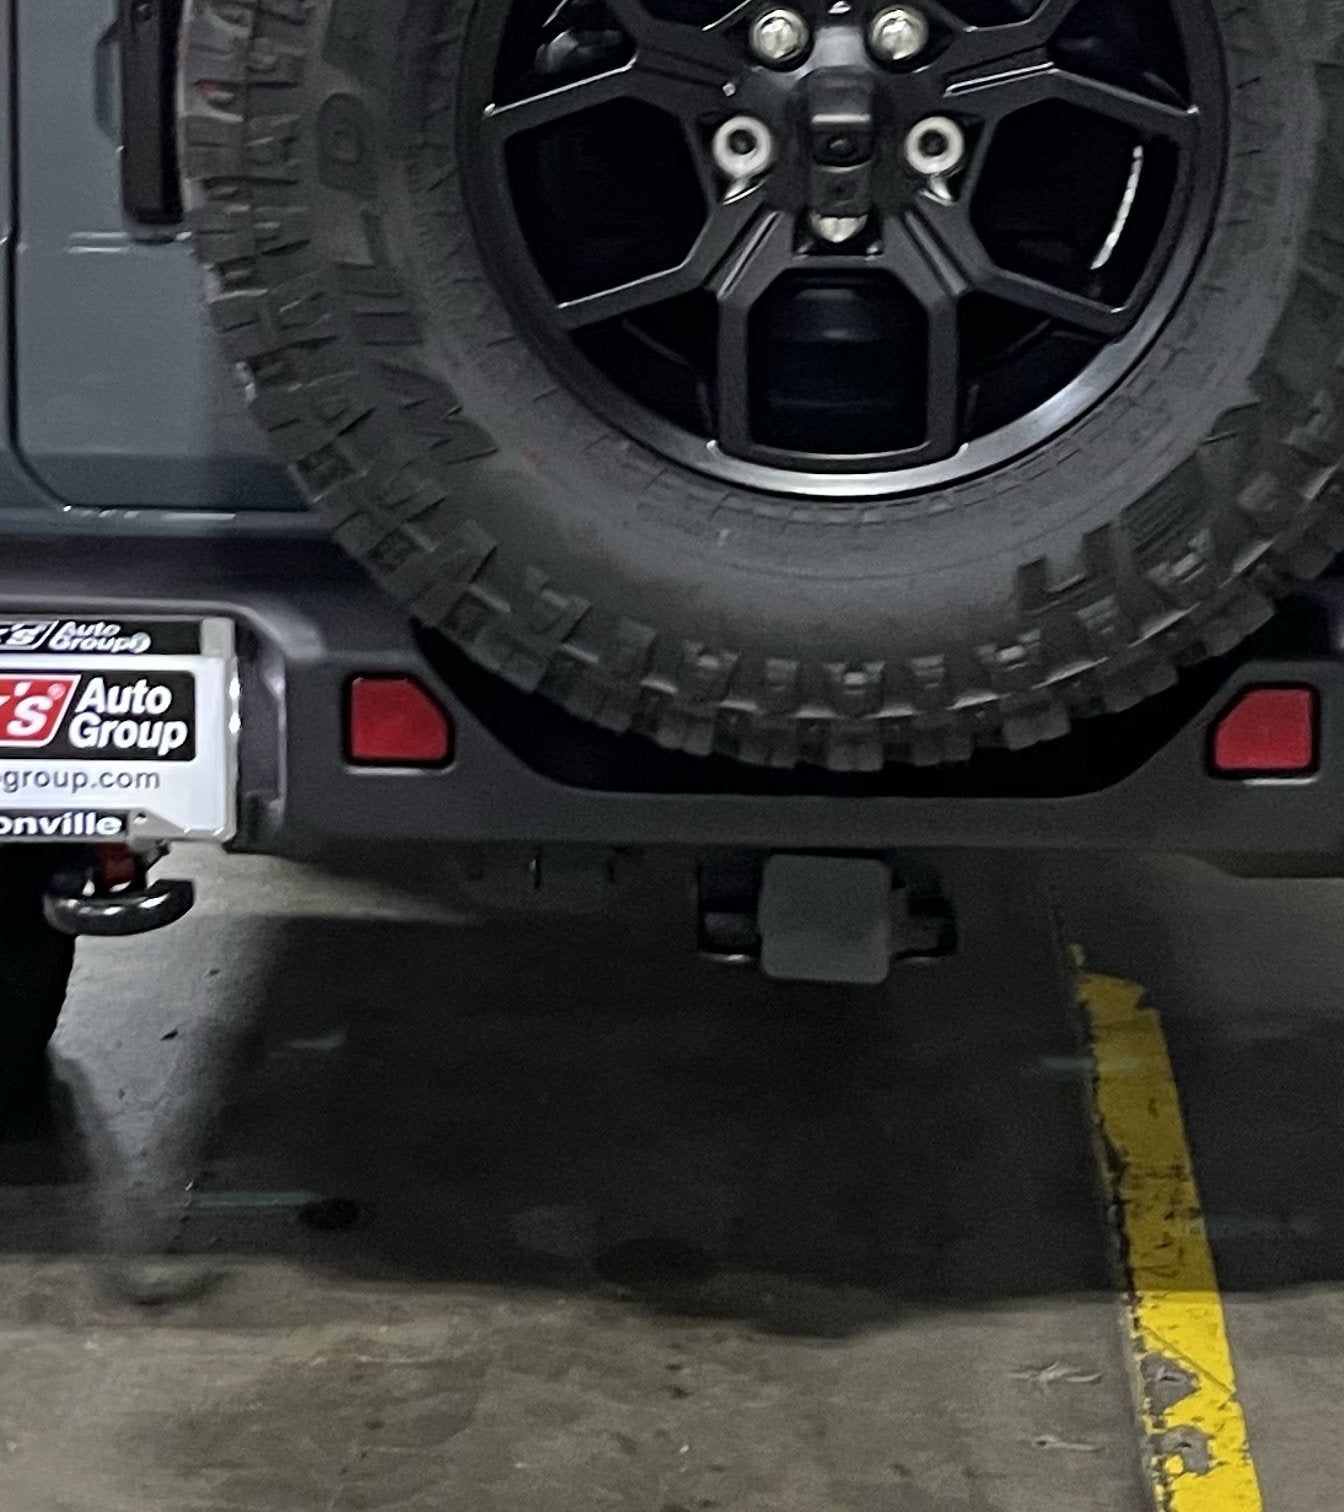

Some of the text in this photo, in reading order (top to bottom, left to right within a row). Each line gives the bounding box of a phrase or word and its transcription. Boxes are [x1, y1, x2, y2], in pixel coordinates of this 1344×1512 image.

[48, 632, 136, 653] Group
[55, 620, 121, 637] Auto
[74, 676, 173, 715] Auto
[68, 711, 189, 757] Group
